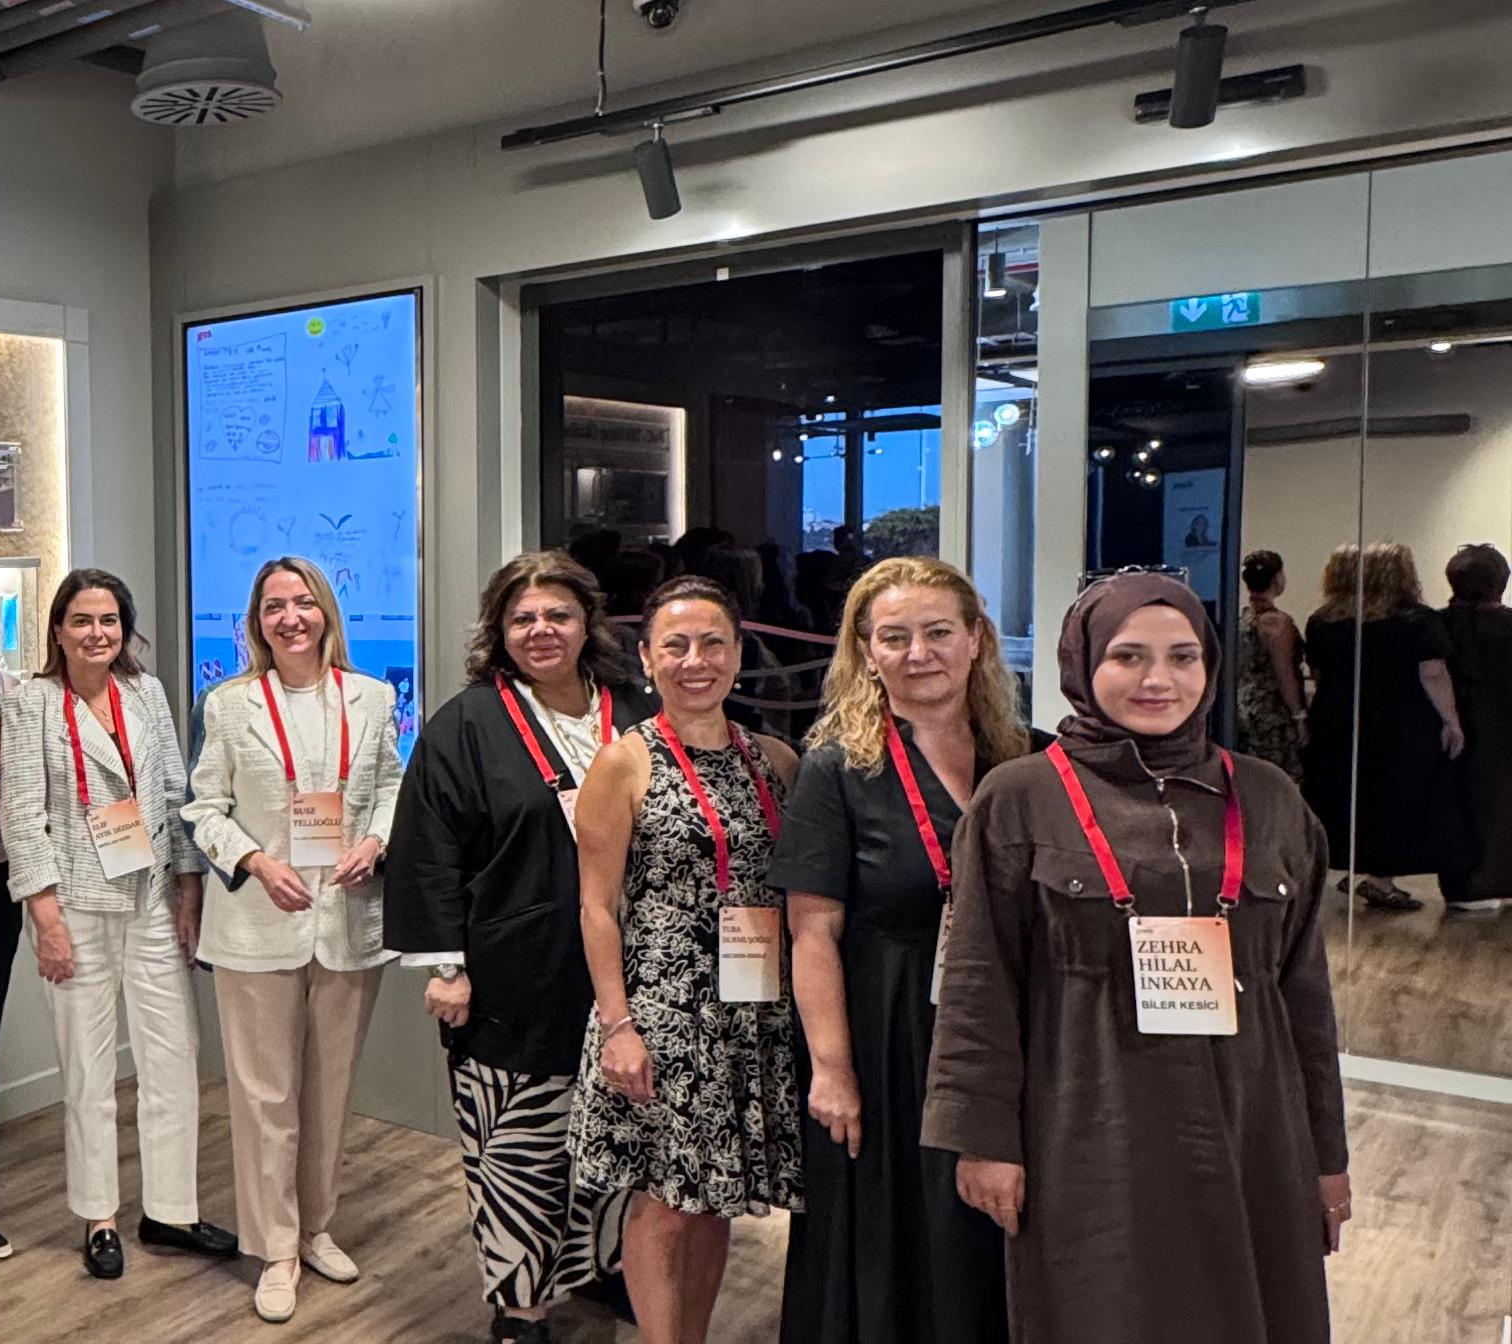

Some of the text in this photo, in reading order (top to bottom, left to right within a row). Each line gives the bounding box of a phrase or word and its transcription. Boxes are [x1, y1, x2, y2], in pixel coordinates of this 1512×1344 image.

[1136, 940, 1204, 955] ZEHRA
[1138, 956, 1197, 972] HİLAL
[1140, 975, 1213, 991] İNKAYA
[1141, 999, 1220, 1011] BİLER KESİCİ
